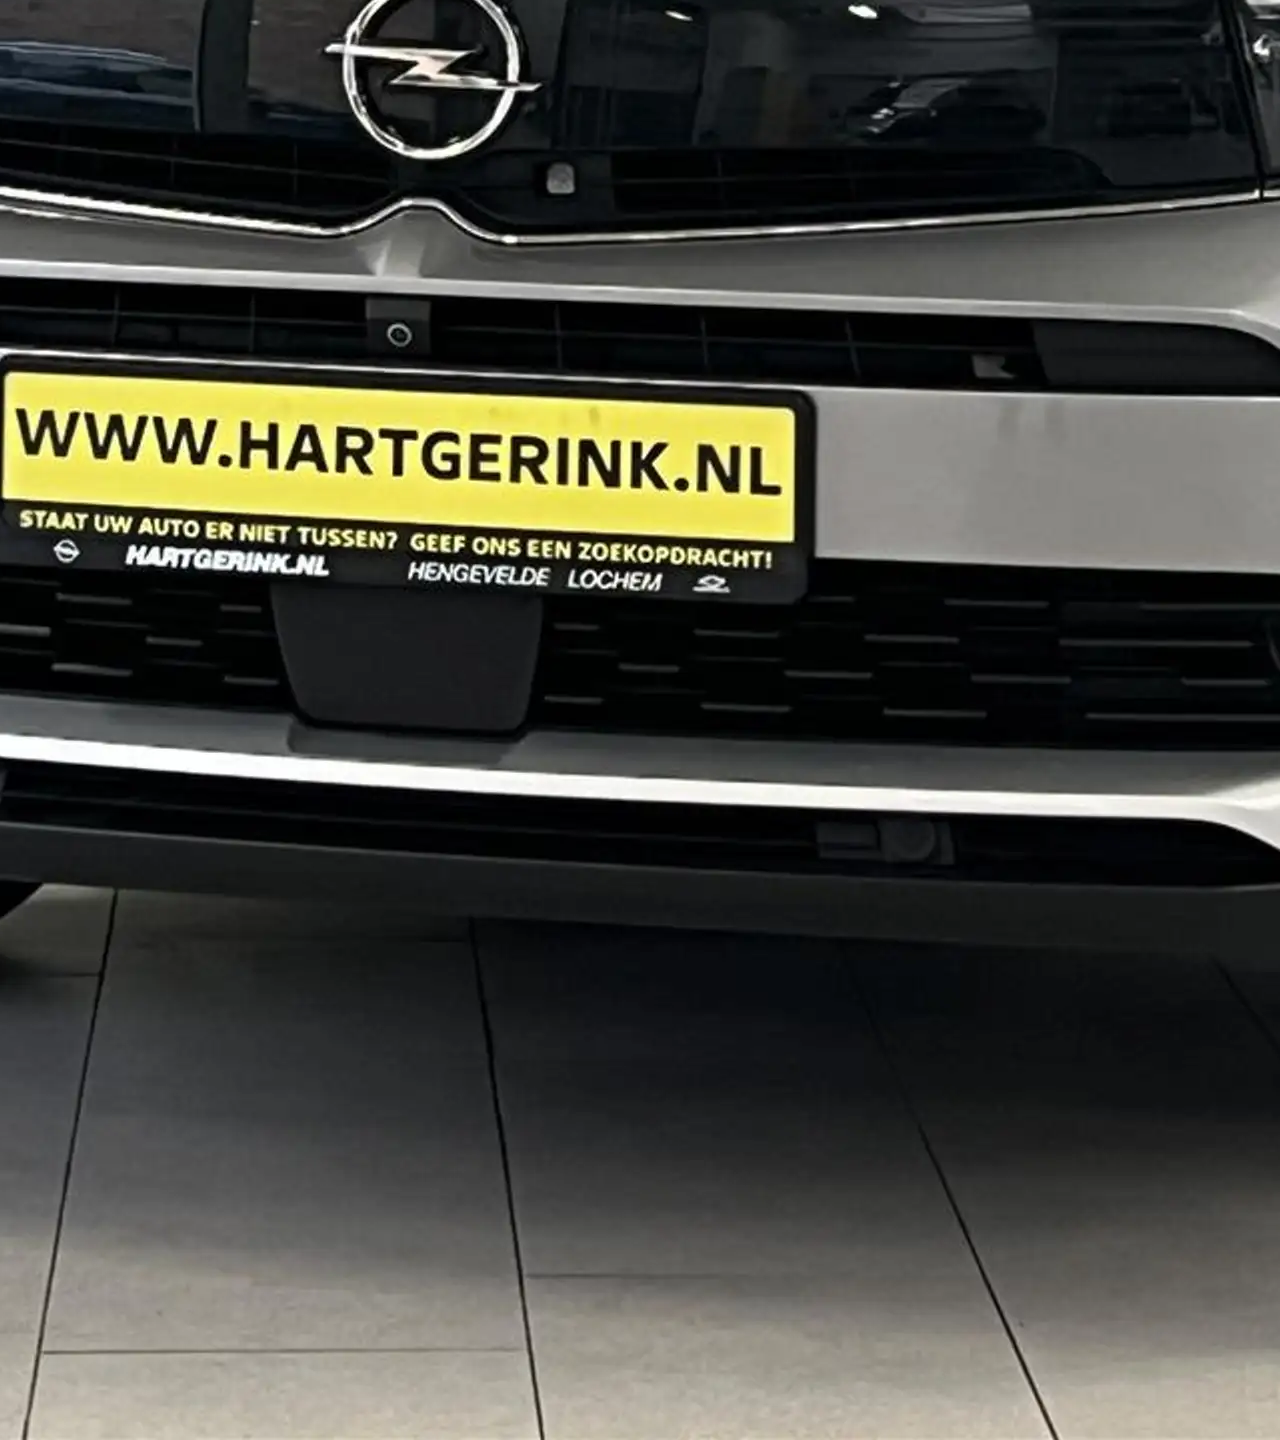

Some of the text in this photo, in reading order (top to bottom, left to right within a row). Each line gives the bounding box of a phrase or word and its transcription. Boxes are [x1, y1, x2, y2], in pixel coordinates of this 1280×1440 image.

[14, 406, 782, 497] WWW.HARTGERINK.NL
[19, 509, 774, 570] STAAT UW AUTO ER NIET TUSSEN? GEEF ONS EEN ZOEKOPDRACHT!
[125, 544, 330, 577] HARTGERINK.NL
[407, 561, 663, 593] HENGEVELDE LOCHEM
